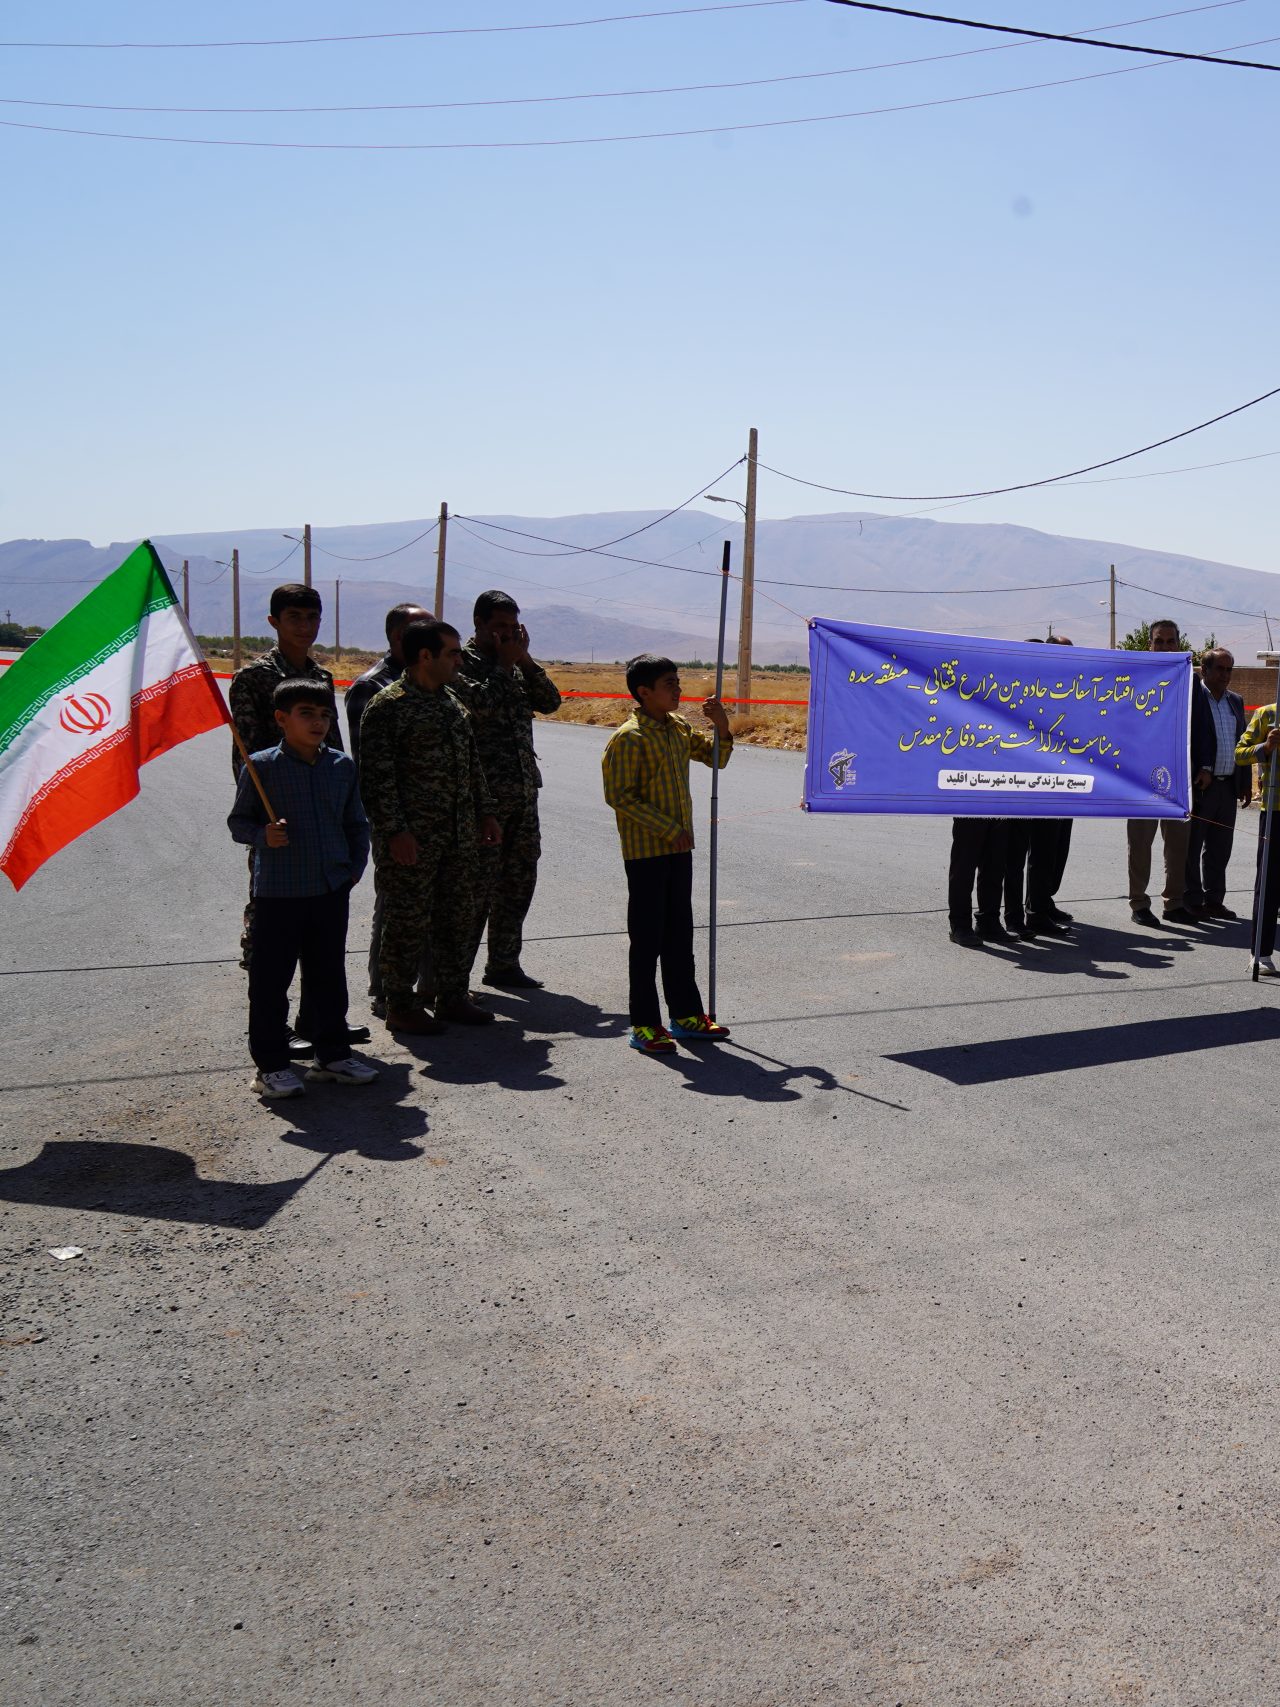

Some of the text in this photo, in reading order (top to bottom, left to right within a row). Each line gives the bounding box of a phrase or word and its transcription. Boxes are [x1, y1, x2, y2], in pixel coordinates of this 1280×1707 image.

[848, 669, 874, 684] سده
[873, 654, 909, 685] منطقه
[959, 673, 998, 700] مزارع
[998, 680, 1023, 710] بین
[1022, 678, 1048, 714] جاده
[1050, 674, 1104, 699] آسفالت
[1097, 675, 1134, 715] افتتاحیه
[1135, 680, 1170, 717] آیین
[899, 713, 1121, 769] به مناسبت بزرگداشت هفته دفاع مقدس
[946, 772, 1087, 790] بسیج سازندگی سپاه شهرستان اقلید
